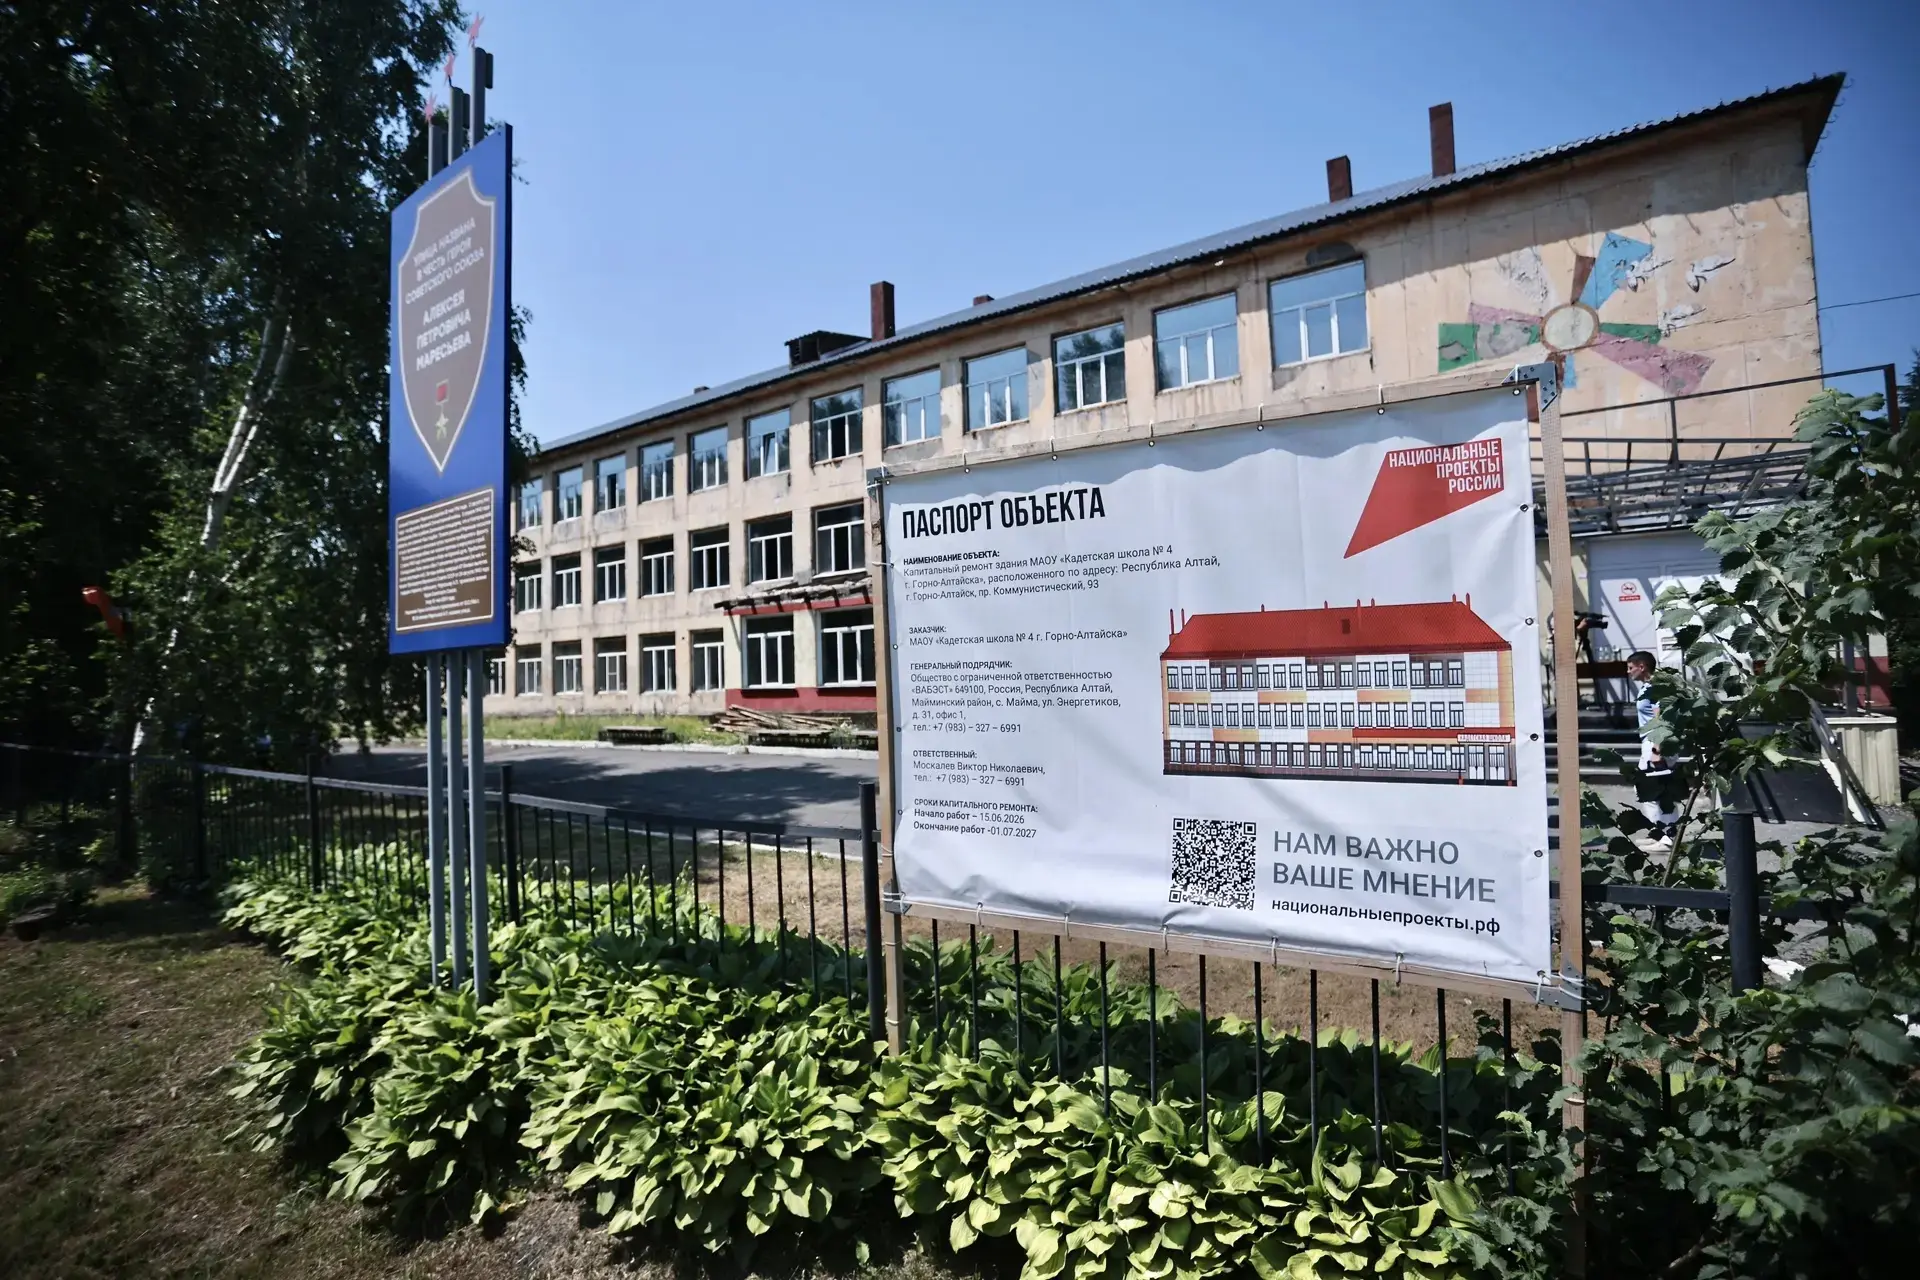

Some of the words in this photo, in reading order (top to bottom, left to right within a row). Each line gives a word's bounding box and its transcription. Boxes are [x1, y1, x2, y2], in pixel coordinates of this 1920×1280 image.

[406, 267, 452, 304] СОВЕТСКОГО
[454, 246, 484, 274] СОЮЗА
[423, 289, 464, 326] АЛЕКСЕЯ
[417, 308, 471, 350] ПЕТРОВИЧА
[417, 331, 472, 371] МАРЕСЬЕВА
[1389, 441, 1499, 468] НАЦИОНАЛЬНЫЕ
[1436, 457, 1500, 479] ПРОЕКТЫ
[1449, 474, 1501, 493] РОССИИ
[902, 500, 994, 538] ПАСПОРТ
[1000, 487, 1105, 528] ОБЪЕКТА
[904, 553, 961, 565] НАИМЕНОВАНИЕ
[963, 550, 1000, 560] ОБЪЕКТА:
[904, 563, 960, 576] Капитальный
[962, 563, 993, 573] ремонт
[996, 560, 1027, 570] здания
[1030, 556, 1057, 566] МАОУ
[1060, 551, 1114, 563] «Кадетская
[1118, 548, 1150, 558] школа
[1153, 546, 1163, 556] №
[1167, 545, 1172, 554] 4
[913, 575, 986, 589] Горно-Алтайска»,
[988, 570, 1064, 584] расположенного
[1082, 566, 1118, 577] адресу:
[1122, 560, 1181, 573] Республика
[1185, 556, 1220, 568] Алтай,
[914, 588, 977, 602] Горно-Алтайск,
[979, 588, 991, 597] пр.
[994, 580, 1086, 596] Коммунистический,
[1088, 579, 1099, 589] 93
[909, 626, 946, 634] ЗАКАЗЧИК:
[910, 637, 933, 646] МАОУ
[936, 636, 984, 646] «Кадетская
[1016, 633, 1026, 642] №
[1045, 630, 1127, 642] Горно-Алтайска»
[911, 661, 961, 670] ГЕНЕРАЛЬНЫЙ
[962, 661, 1012, 670] ПОДРЯДЧИК:
[911, 674, 952, 682] Общество
[960, 672, 1022, 683] ограниченной
[1024, 671, 1112, 680] ответственностью
[912, 685, 952, 694] «ВАБЭСТ»
[955, 685, 986, 694] 649100,
[988, 685, 1023, 694] Россия,
[1025, 684, 1078, 695] Республика
[1081, 683, 1113, 693] Алтай,
[912, 698, 965, 706] Майминский
[967, 698, 994, 708] район,
[1006, 698, 1040, 707] Майма,
[1042, 700, 1054, 708] ул.
[1057, 697, 1121, 708] Энергетиков,
[922, 711, 934, 720] 31,
[936, 710, 957, 720] офис
[960, 711, 966, 720] 1,
[933, 723, 943, 731] +7
[945, 722, 966, 733] (983)
[975, 724, 990, 732] 327
[1000, 724, 1021, 732] 6991
[913, 750, 977, 759] ОТВЕТСТВЕННЫЙ:
[914, 761, 955, 770] Москалев
[957, 762, 987, 773] Виктор
[990, 763, 1046, 775] Николаевич,
[914, 774, 931, 782] тел.:
[936, 774, 946, 782] +7
[948, 774, 970, 785] (983)
[980, 776, 995, 784] 327
[1005, 777, 1024, 786] 6991
[939, 800, 998, 810] КАПИТАЛЬНОГО
[1000, 803, 1038, 812] РЕМОНТА:
[914, 809, 944, 818] Начало
[946, 811, 970, 820] работ
[980, 813, 1025, 824] 15.06.2026
[914, 821, 959, 832] Окончание
[961, 825, 985, 834] работ
[987, 827, 1036, 838] -01.07.2027
[1274, 831, 1336, 856] НАМ
[1346, 836, 1459, 864] ВАЖНО
[1273, 862, 1354, 890] ВАШЕ
[1364, 870, 1496, 903] МНЕНИЕ
[1272, 900, 1500, 936] национальныепроекты.рф
